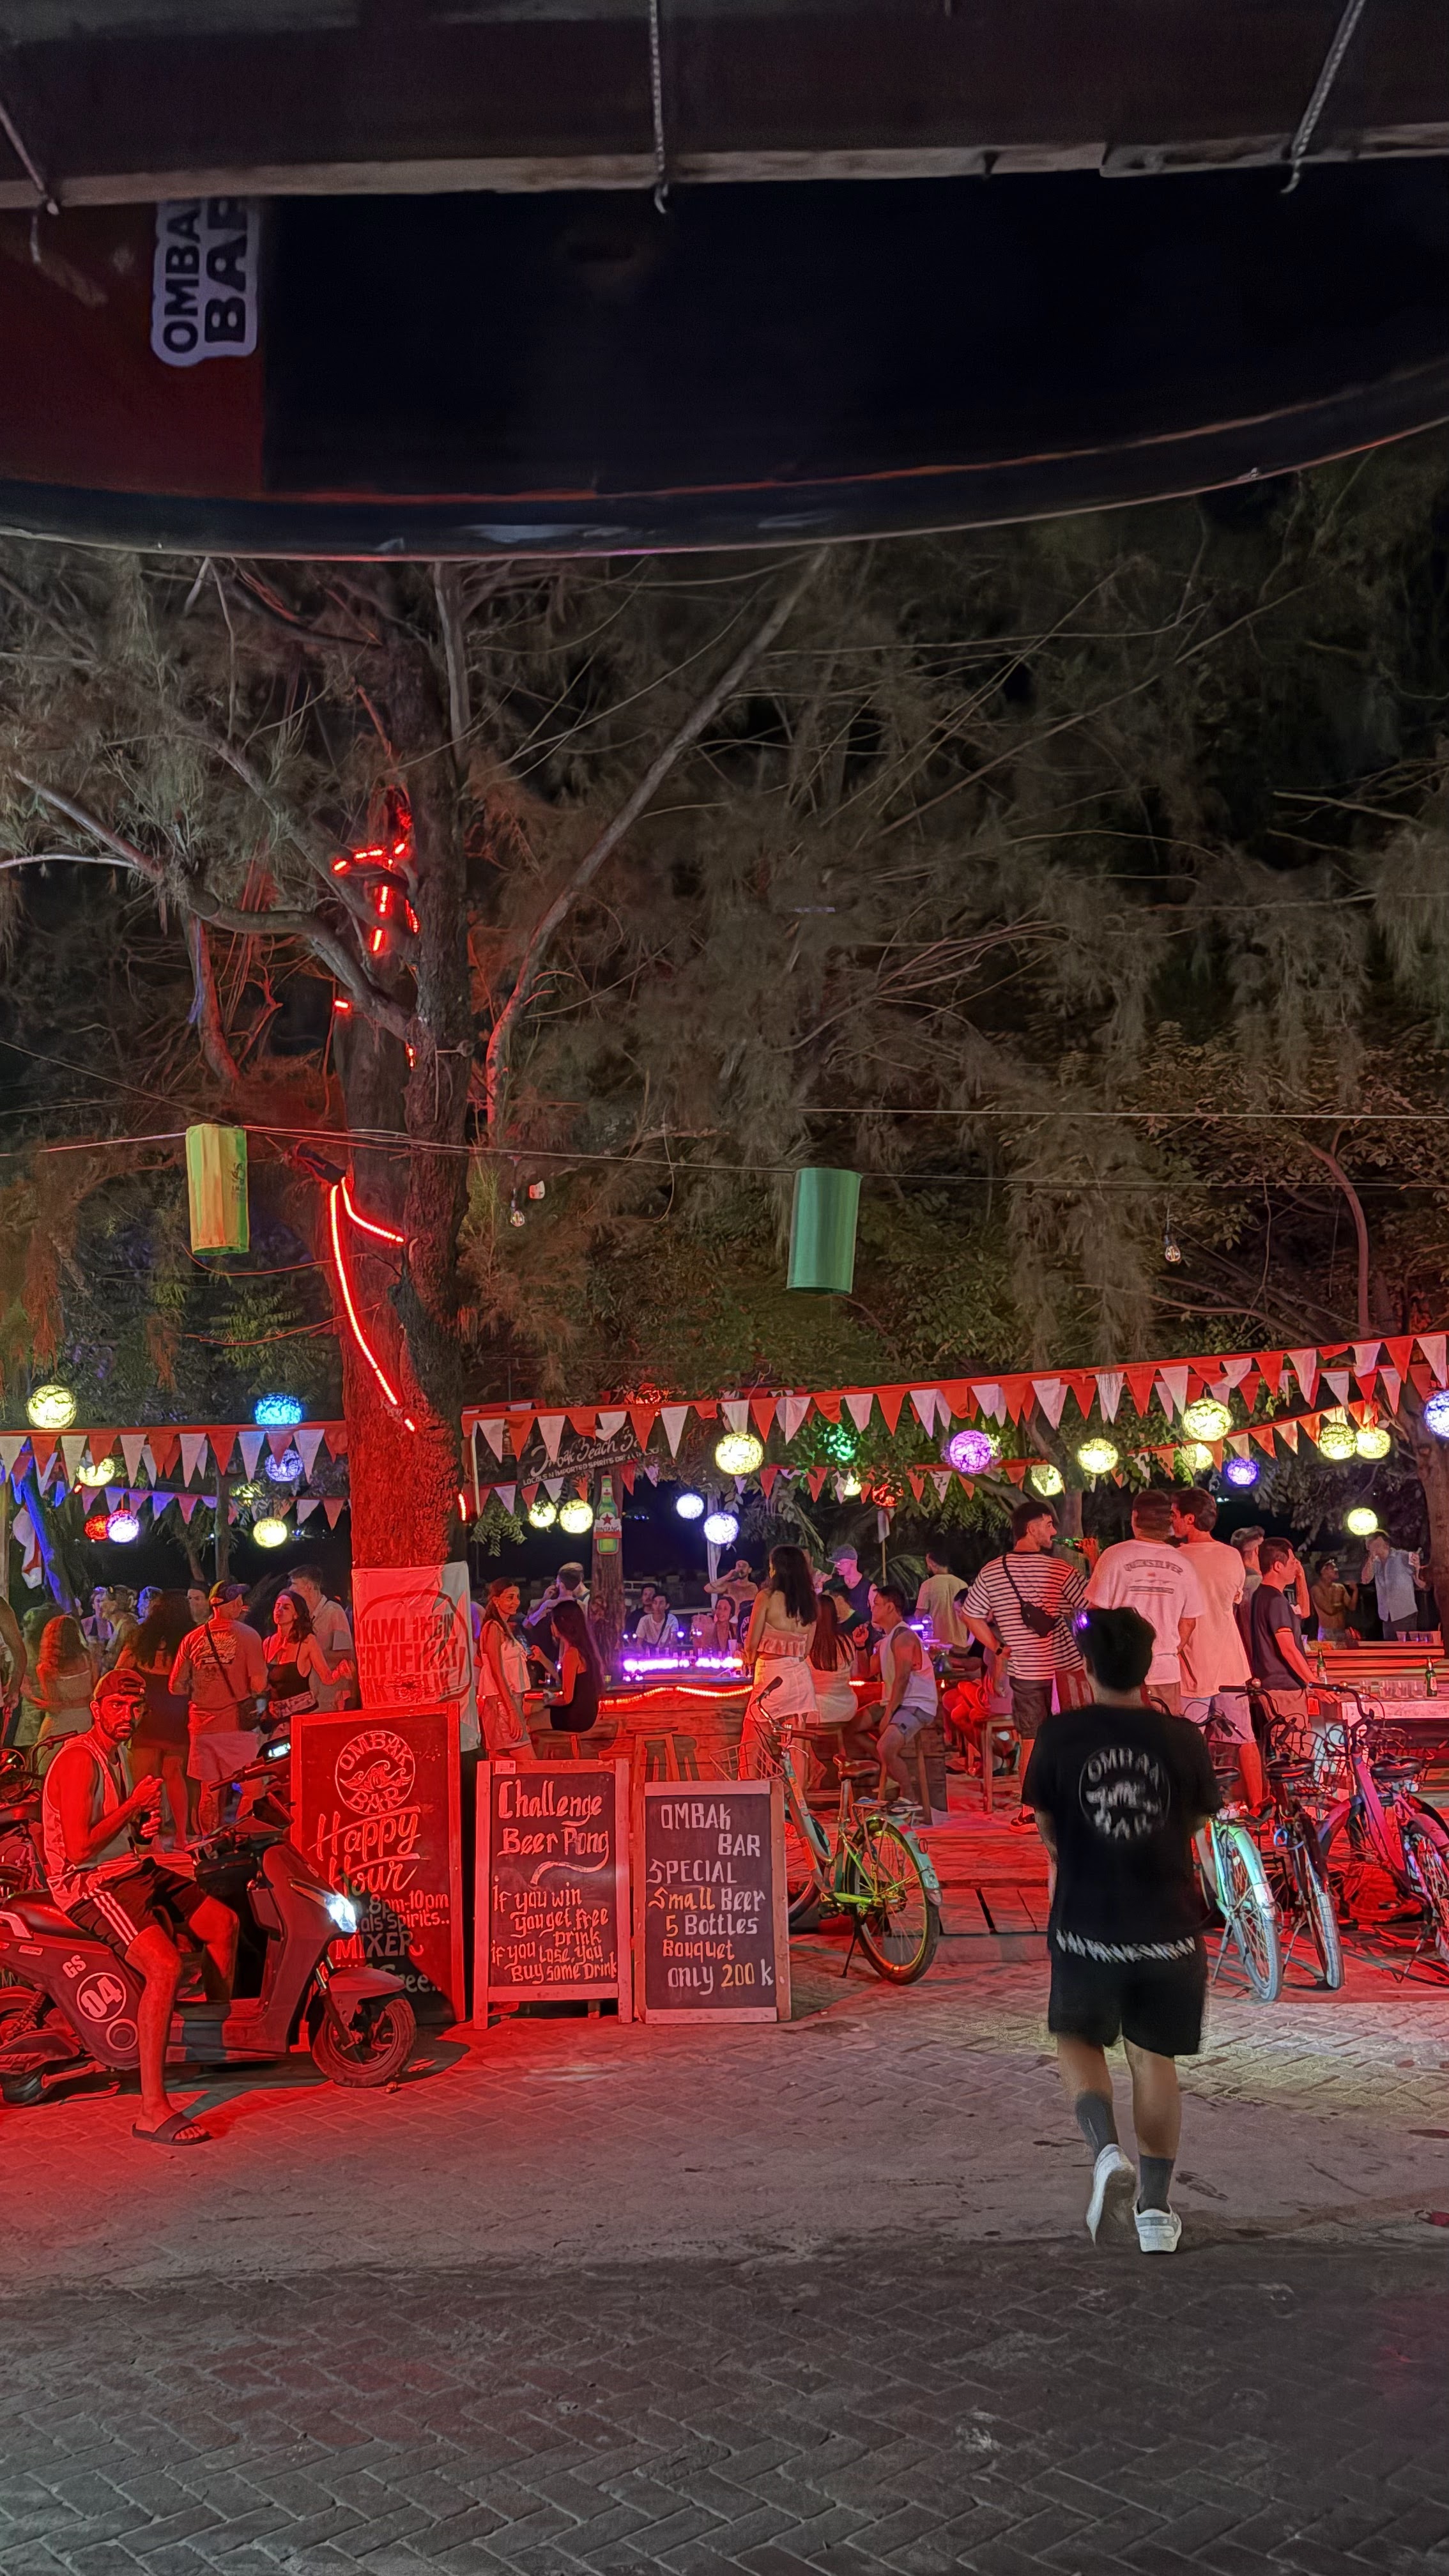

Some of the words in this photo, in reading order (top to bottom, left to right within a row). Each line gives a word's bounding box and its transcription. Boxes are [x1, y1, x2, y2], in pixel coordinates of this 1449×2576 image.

[555, 1463, 588, 1476] IMPORTED
[357, 1637, 458, 1676] ERTIFIKAT
[340, 1733, 413, 1770] OMBAK
[346, 1788, 406, 1813] BAR
[498, 1779, 602, 1827] Challenge
[308, 1805, 422, 1862] Happy
[497, 1827, 558, 1857] Beer
[717, 1833, 761, 1857] BAR
[329, 1853, 421, 1897] Hour
[647, 1859, 737, 1884] SPECIAL
[510, 1891, 547, 1920] you
[551, 1882, 583, 1906] win
[648, 1887, 716, 1911] Small
[720, 1887, 766, 1913] Beer
[665, 1914, 678, 1937] 5
[685, 1913, 760, 1936] Bottles
[663, 1939, 735, 1963] Bouquet
[62, 1954, 86, 1979] GS
[511, 1963, 544, 1985] Buy
[546, 1964, 580, 1982] some
[721, 1963, 755, 1988] 200
[80, 1976, 123, 2018] 04
